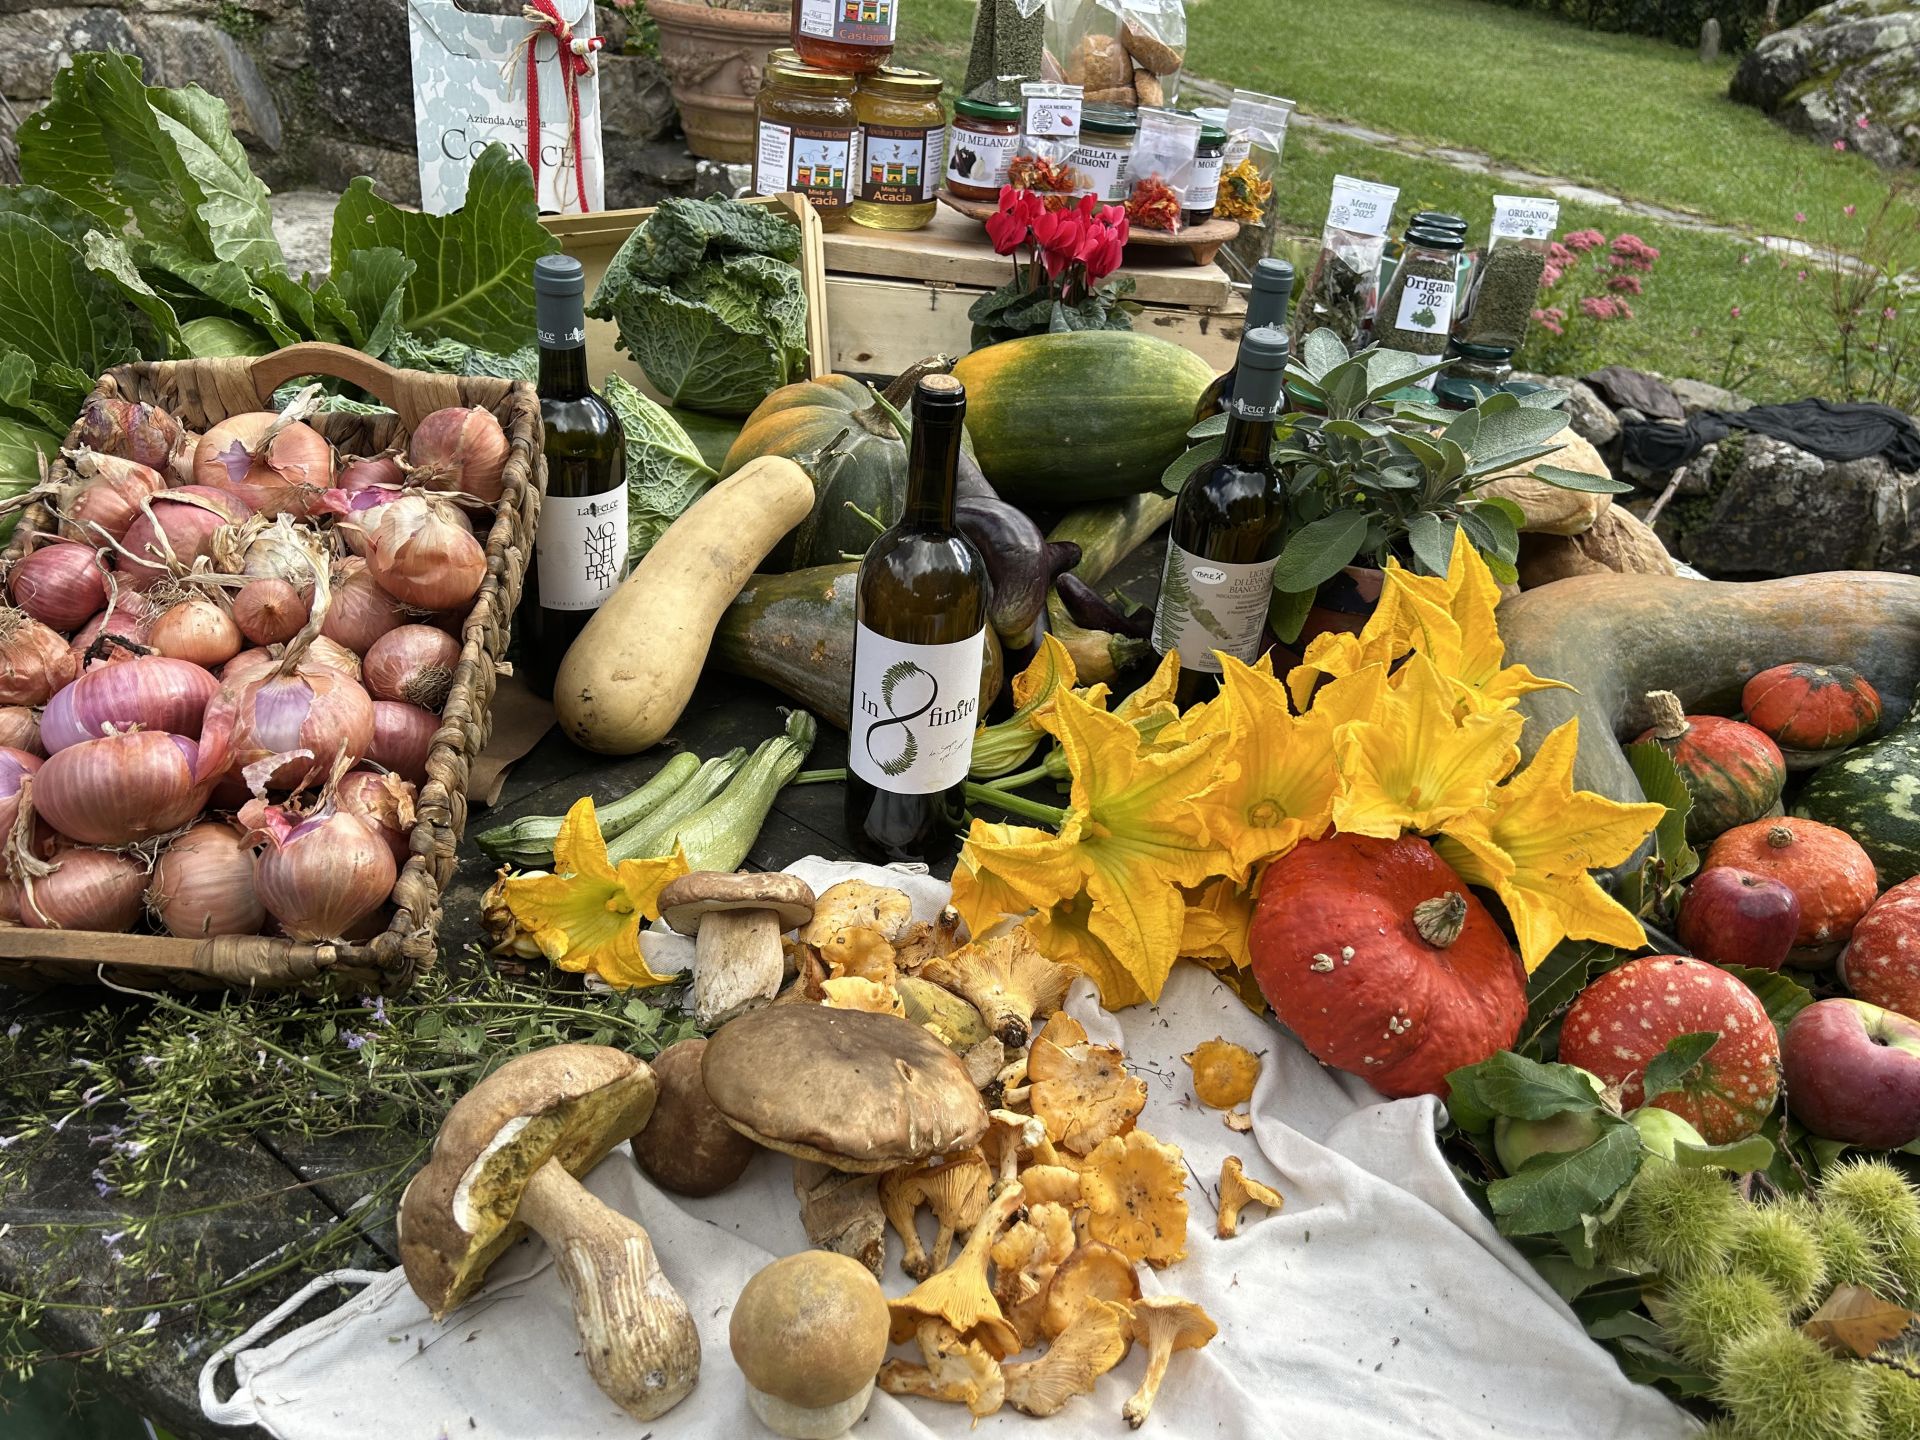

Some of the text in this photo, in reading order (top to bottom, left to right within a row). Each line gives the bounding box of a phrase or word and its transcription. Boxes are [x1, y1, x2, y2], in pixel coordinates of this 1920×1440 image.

[840, 29, 889, 43] Castagno
[466, 113, 547, 128] Azienda Agria
[957, 132, 967, 142] DI
[1069, 156, 1110, 169] DI LIMONI
[809, 196, 838, 205] cacia
[873, 191, 912, 202] Acacia
[1350, 199, 1377, 210] Menta
[1353, 209, 1376, 219] 2025
[1508, 208, 1549, 219] ORIGANO
[1519, 219, 1538, 228] 2025
[1405, 276, 1455, 294] Origano
[586, 521, 615, 541] MO
[584, 533, 617, 555] NTE
[585, 548, 614, 567] DEI
[585, 562, 617, 581] FRA
[599, 574, 611, 591] TI
[1235, 578, 1245, 586] DI
[1229, 584, 1261, 594] BIANCO
[861, 690, 879, 718] In
[928, 697, 976, 728] finito
